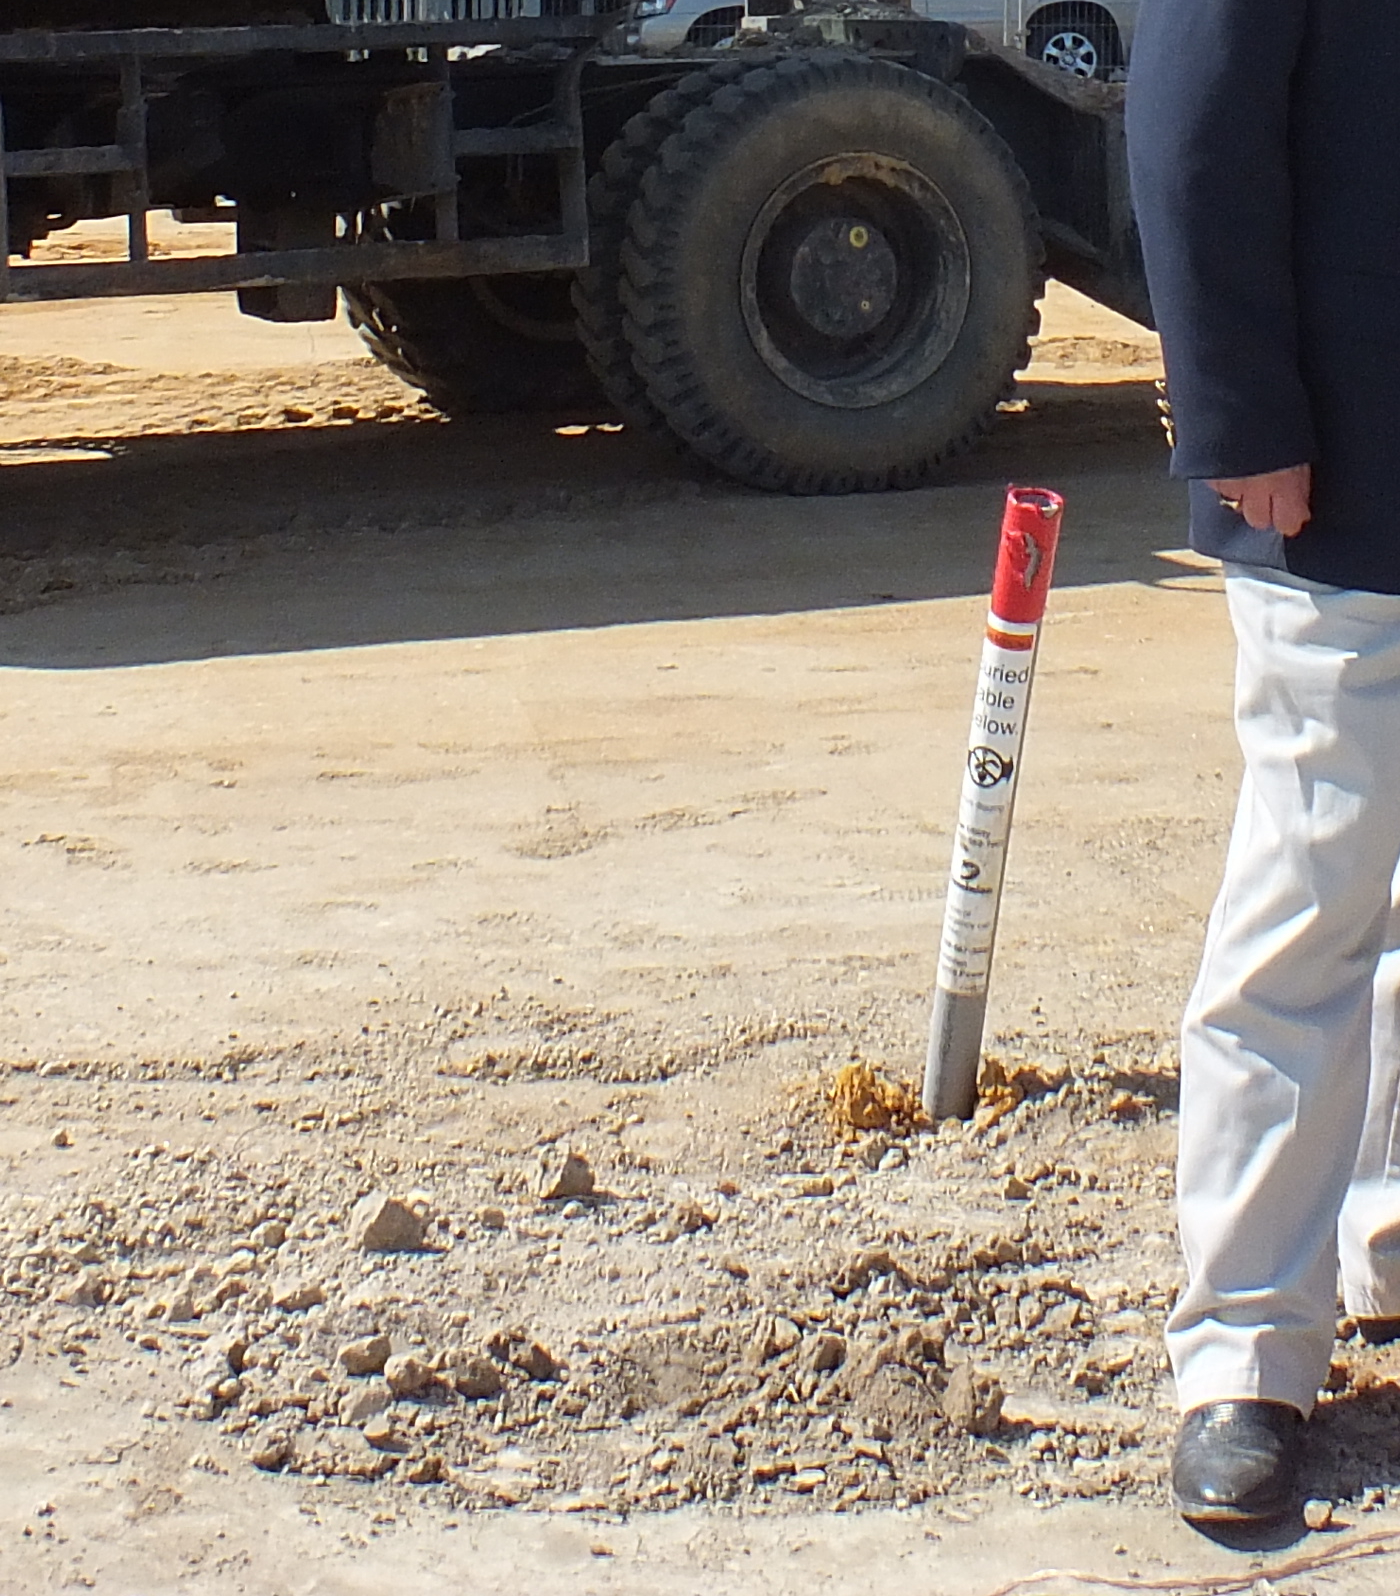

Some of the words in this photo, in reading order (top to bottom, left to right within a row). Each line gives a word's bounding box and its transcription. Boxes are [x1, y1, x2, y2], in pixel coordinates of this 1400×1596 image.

[983, 663, 1030, 684] uried
[979, 687, 1015, 709] able
[975, 714, 1019, 736] elow.
